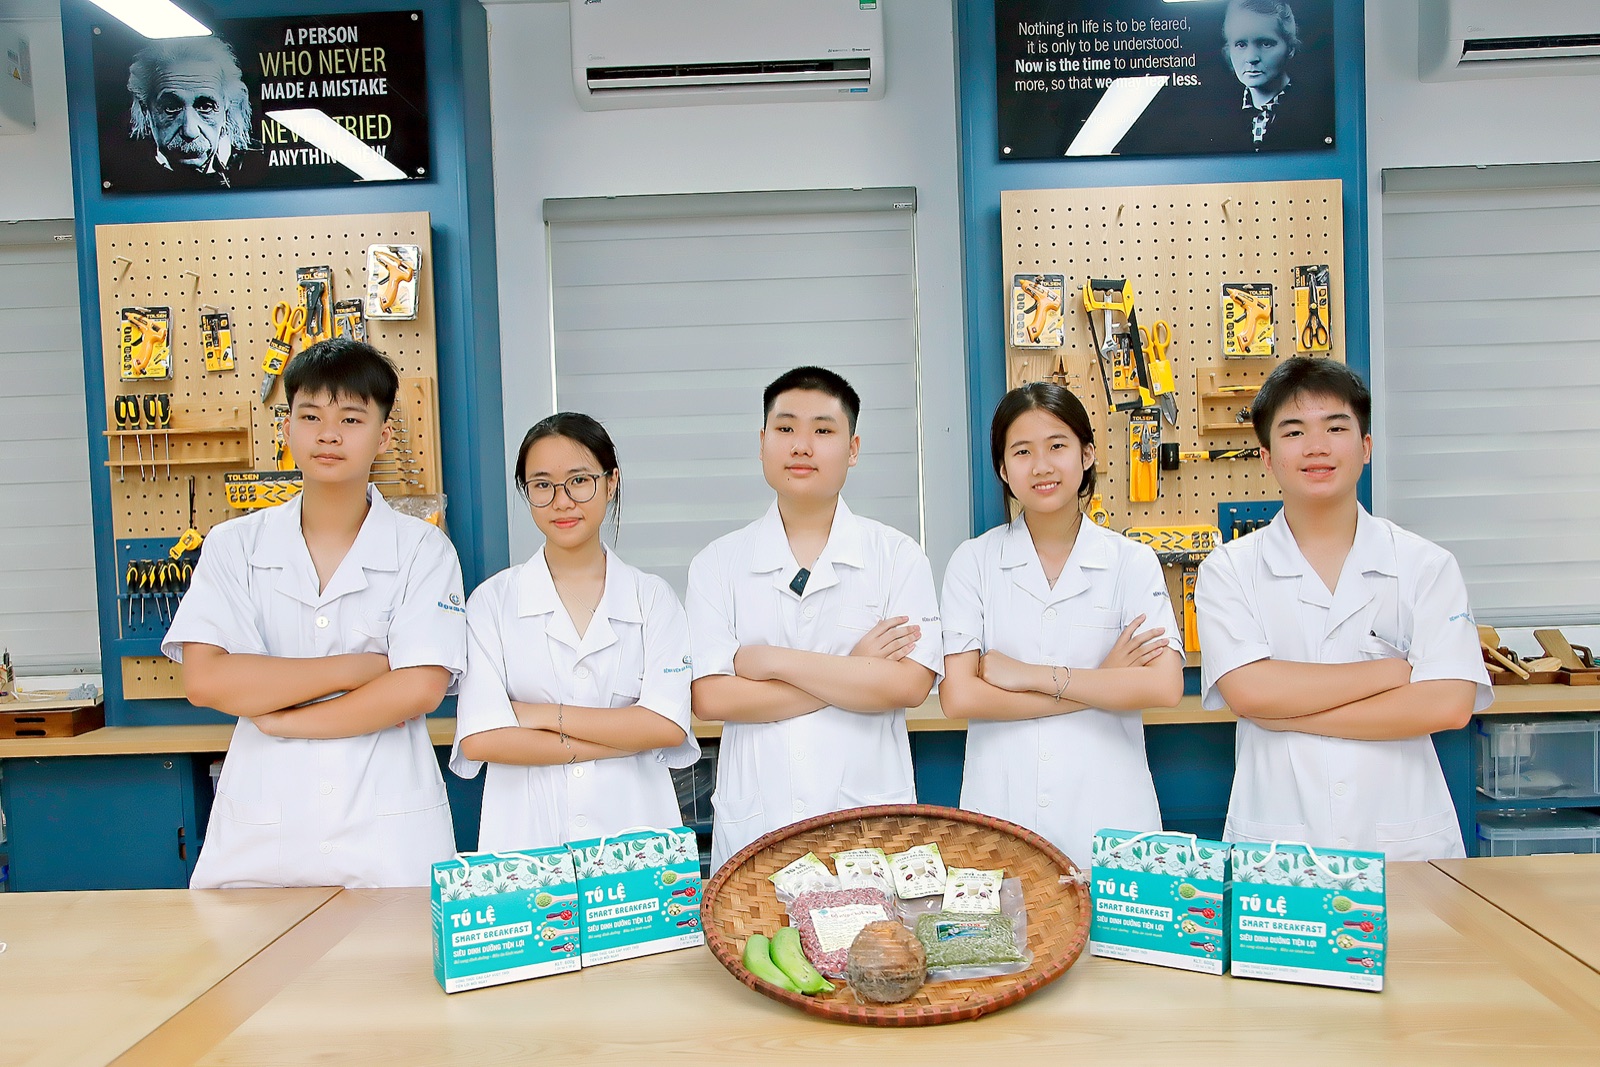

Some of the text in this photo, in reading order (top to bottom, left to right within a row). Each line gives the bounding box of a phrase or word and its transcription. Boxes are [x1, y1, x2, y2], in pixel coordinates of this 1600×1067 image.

[285, 26, 358, 45] A PERSON
[1019, 17, 1190, 37] Nothing in life is to be feared,
[1027, 36, 1182, 55] it is only to be understood.
[259, 47, 386, 76] WHO NEVER
[1016, 54, 1195, 72] Now is the time to understand
[261, 78, 387, 100] MADE A MISTAKE
[1015, 80, 1048, 92] more,
[1051, 79, 1065, 90] so
[1068, 76, 1092, 89] that
[1095, 77, 1112, 89] we
[1173, 73, 1201, 86] less.
[332, 114, 392, 139] TRIED
[300, 272, 328, 280] TOLSEN
[584, 882, 626, 904] TÚ LỆ
[1097, 878, 1138, 901] TÚ LỆ
[589, 901, 657, 918] SMART BREAKFAST
[1099, 902, 1169, 918] SMART BREAKFAST
[1239, 894, 1287, 916] TÚ LỆ
[451, 905, 496, 928] TÚ LỆ
[455, 925, 529, 943] SMART BREAKFAST
[1242, 920, 1323, 933] SMART BREAKFAST
[1254, 935, 1268, 943] DINH
[468, 947, 480, 955] DINH
